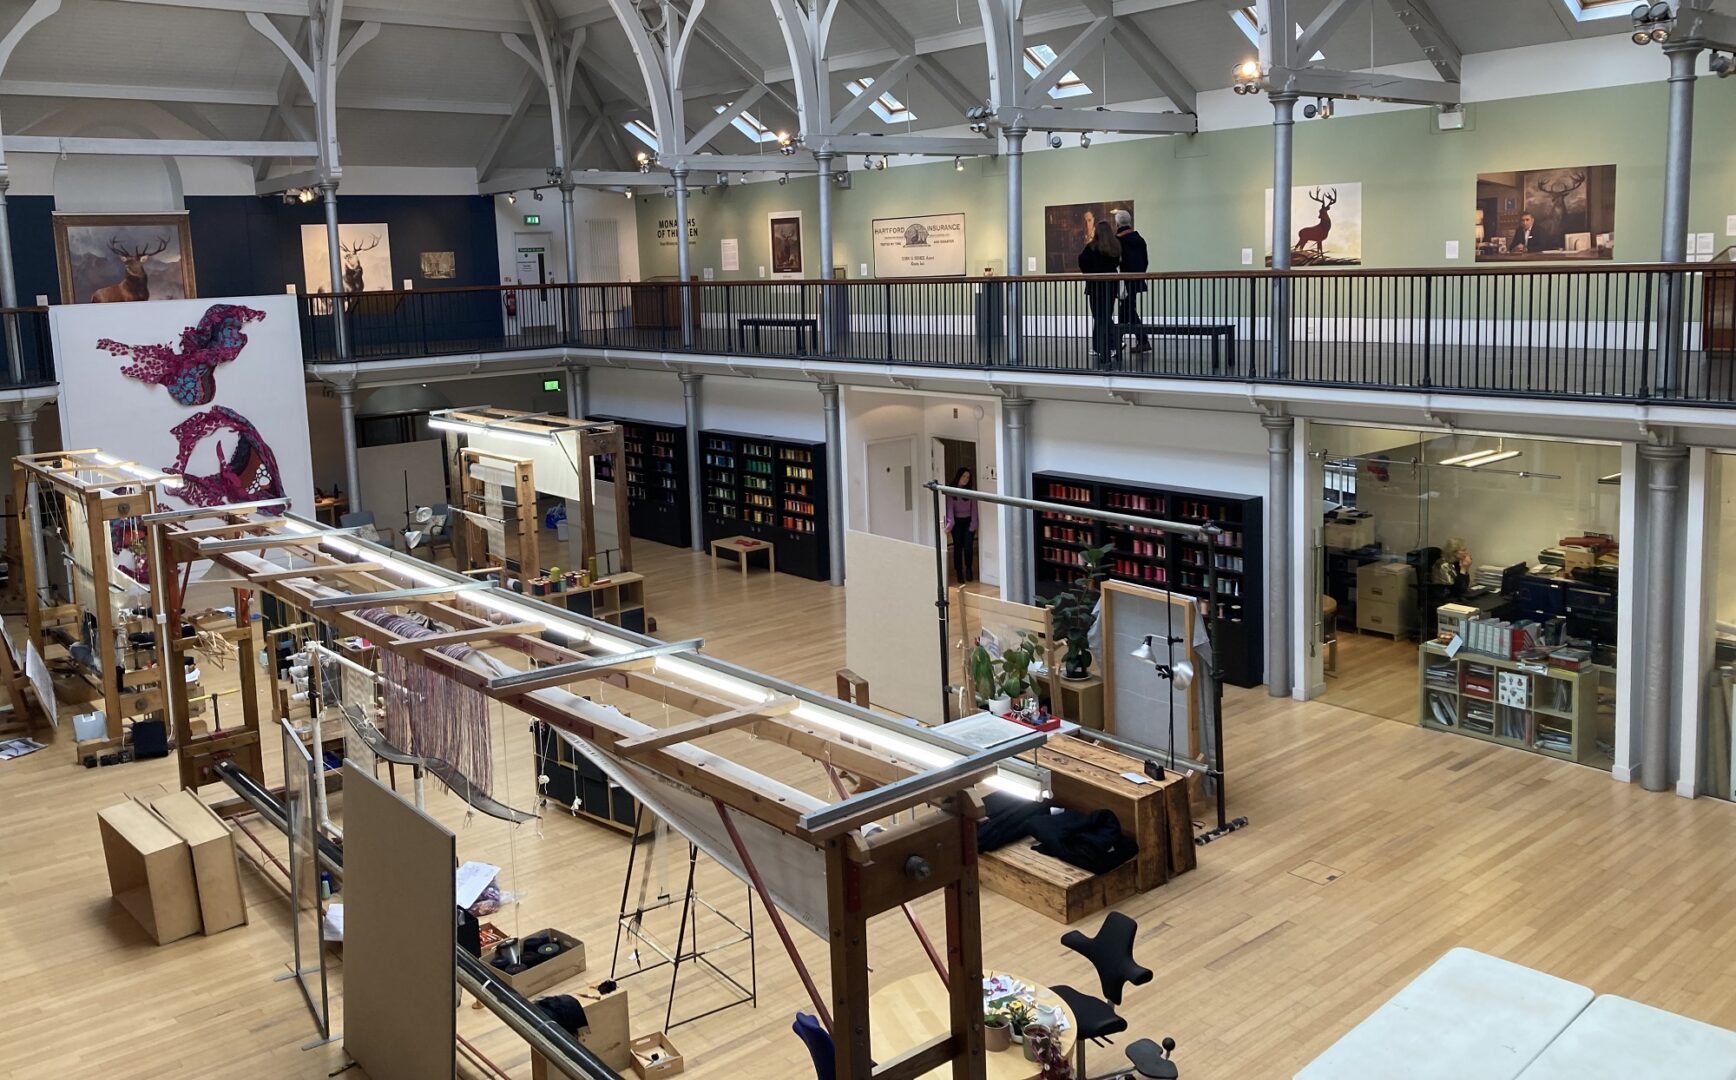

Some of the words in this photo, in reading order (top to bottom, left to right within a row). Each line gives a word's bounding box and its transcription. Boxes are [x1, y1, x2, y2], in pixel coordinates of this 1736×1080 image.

[658, 218, 696, 228] MONAHS
[658, 230, 665, 238] OF
[875, 226, 905, 234] HARTFORD
[927, 224, 960, 232] INSURANCE
